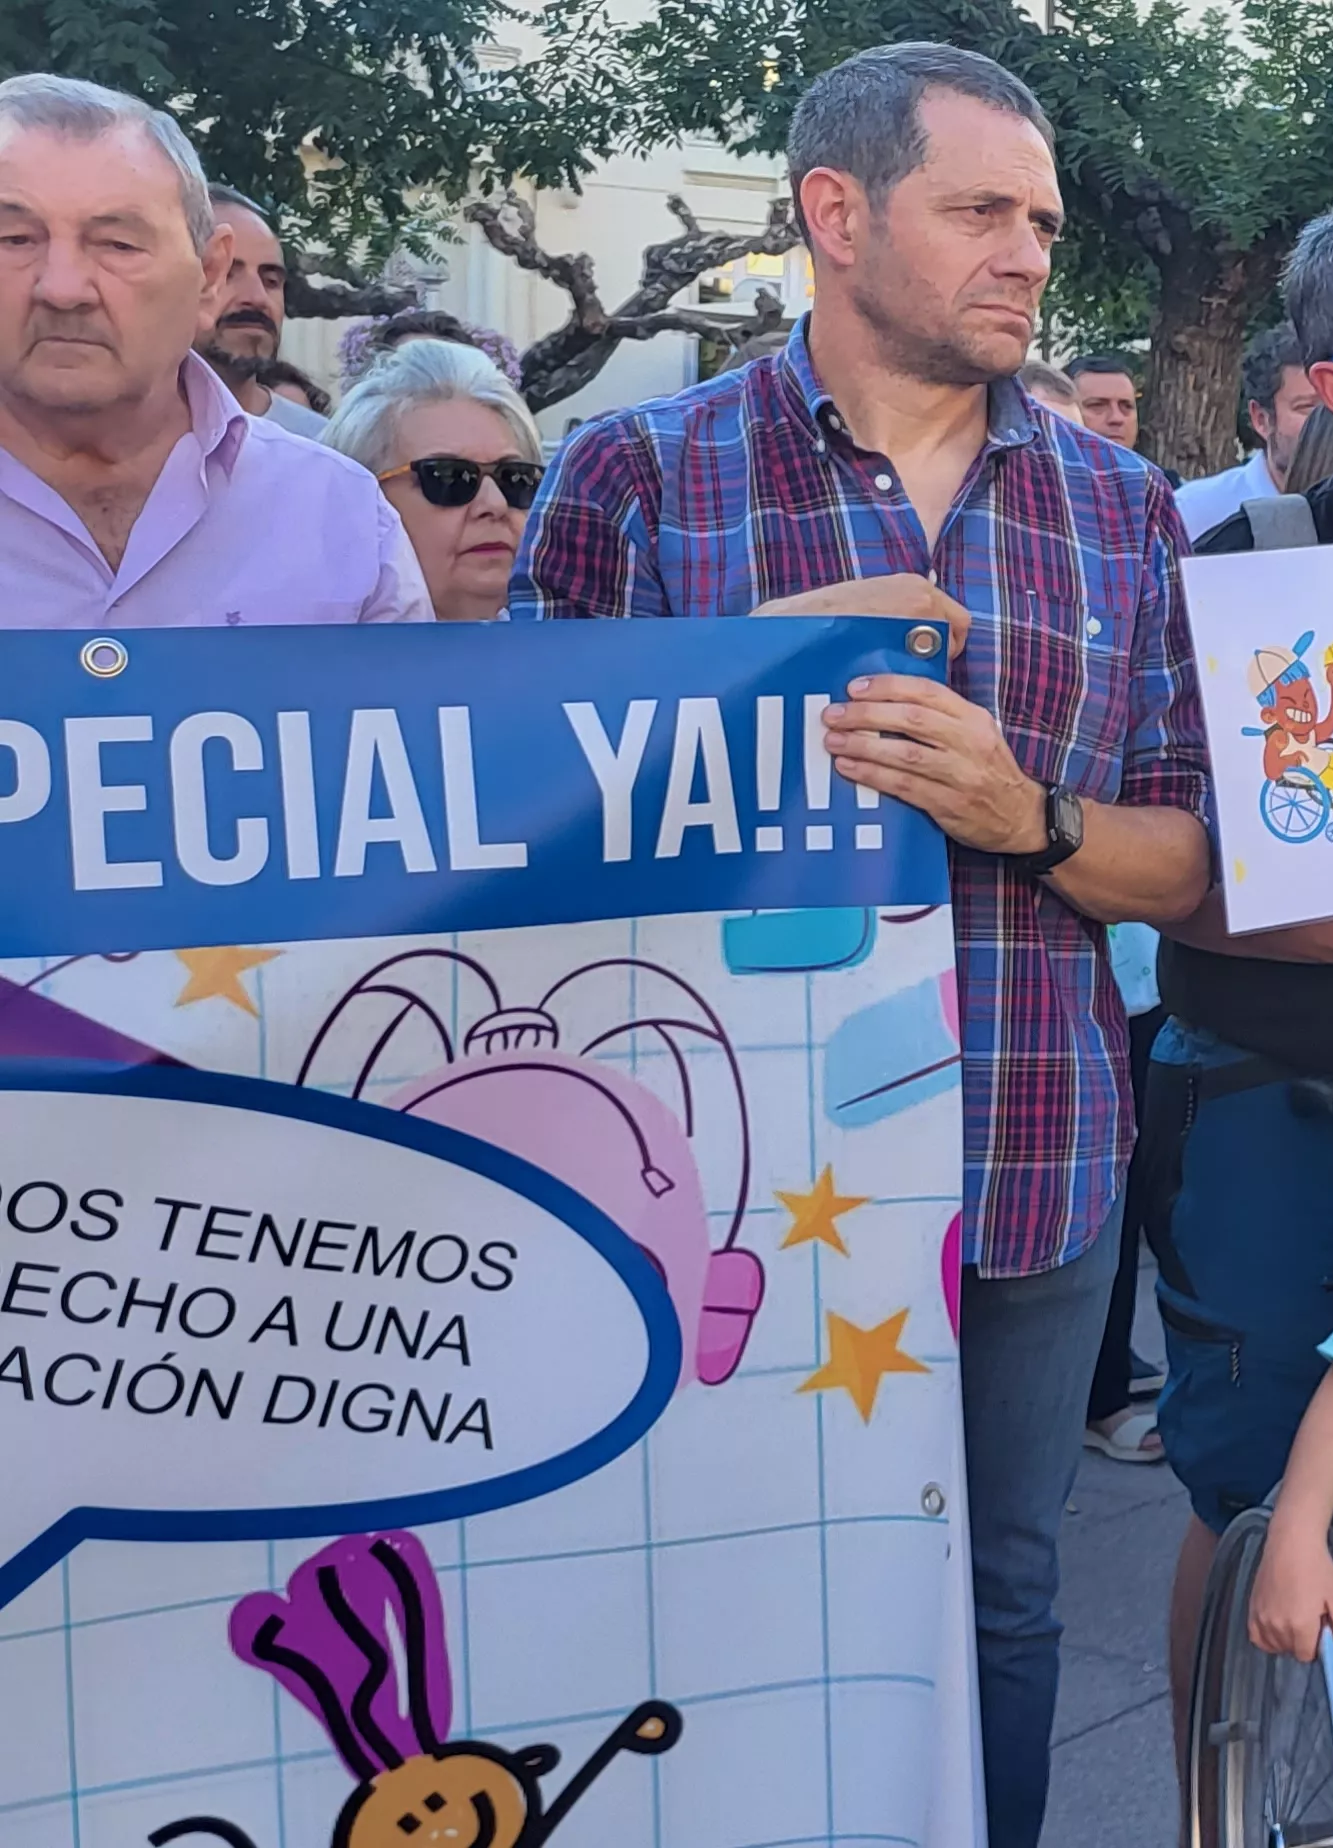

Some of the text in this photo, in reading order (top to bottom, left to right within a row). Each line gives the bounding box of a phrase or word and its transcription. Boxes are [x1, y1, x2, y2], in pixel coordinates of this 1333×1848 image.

[0, 1180, 518, 1292] OS TENEMOS
[0, 1261, 471, 1367] ECHO A UNA
[0, 1345, 493, 1450] ACIÓN DIGNA
